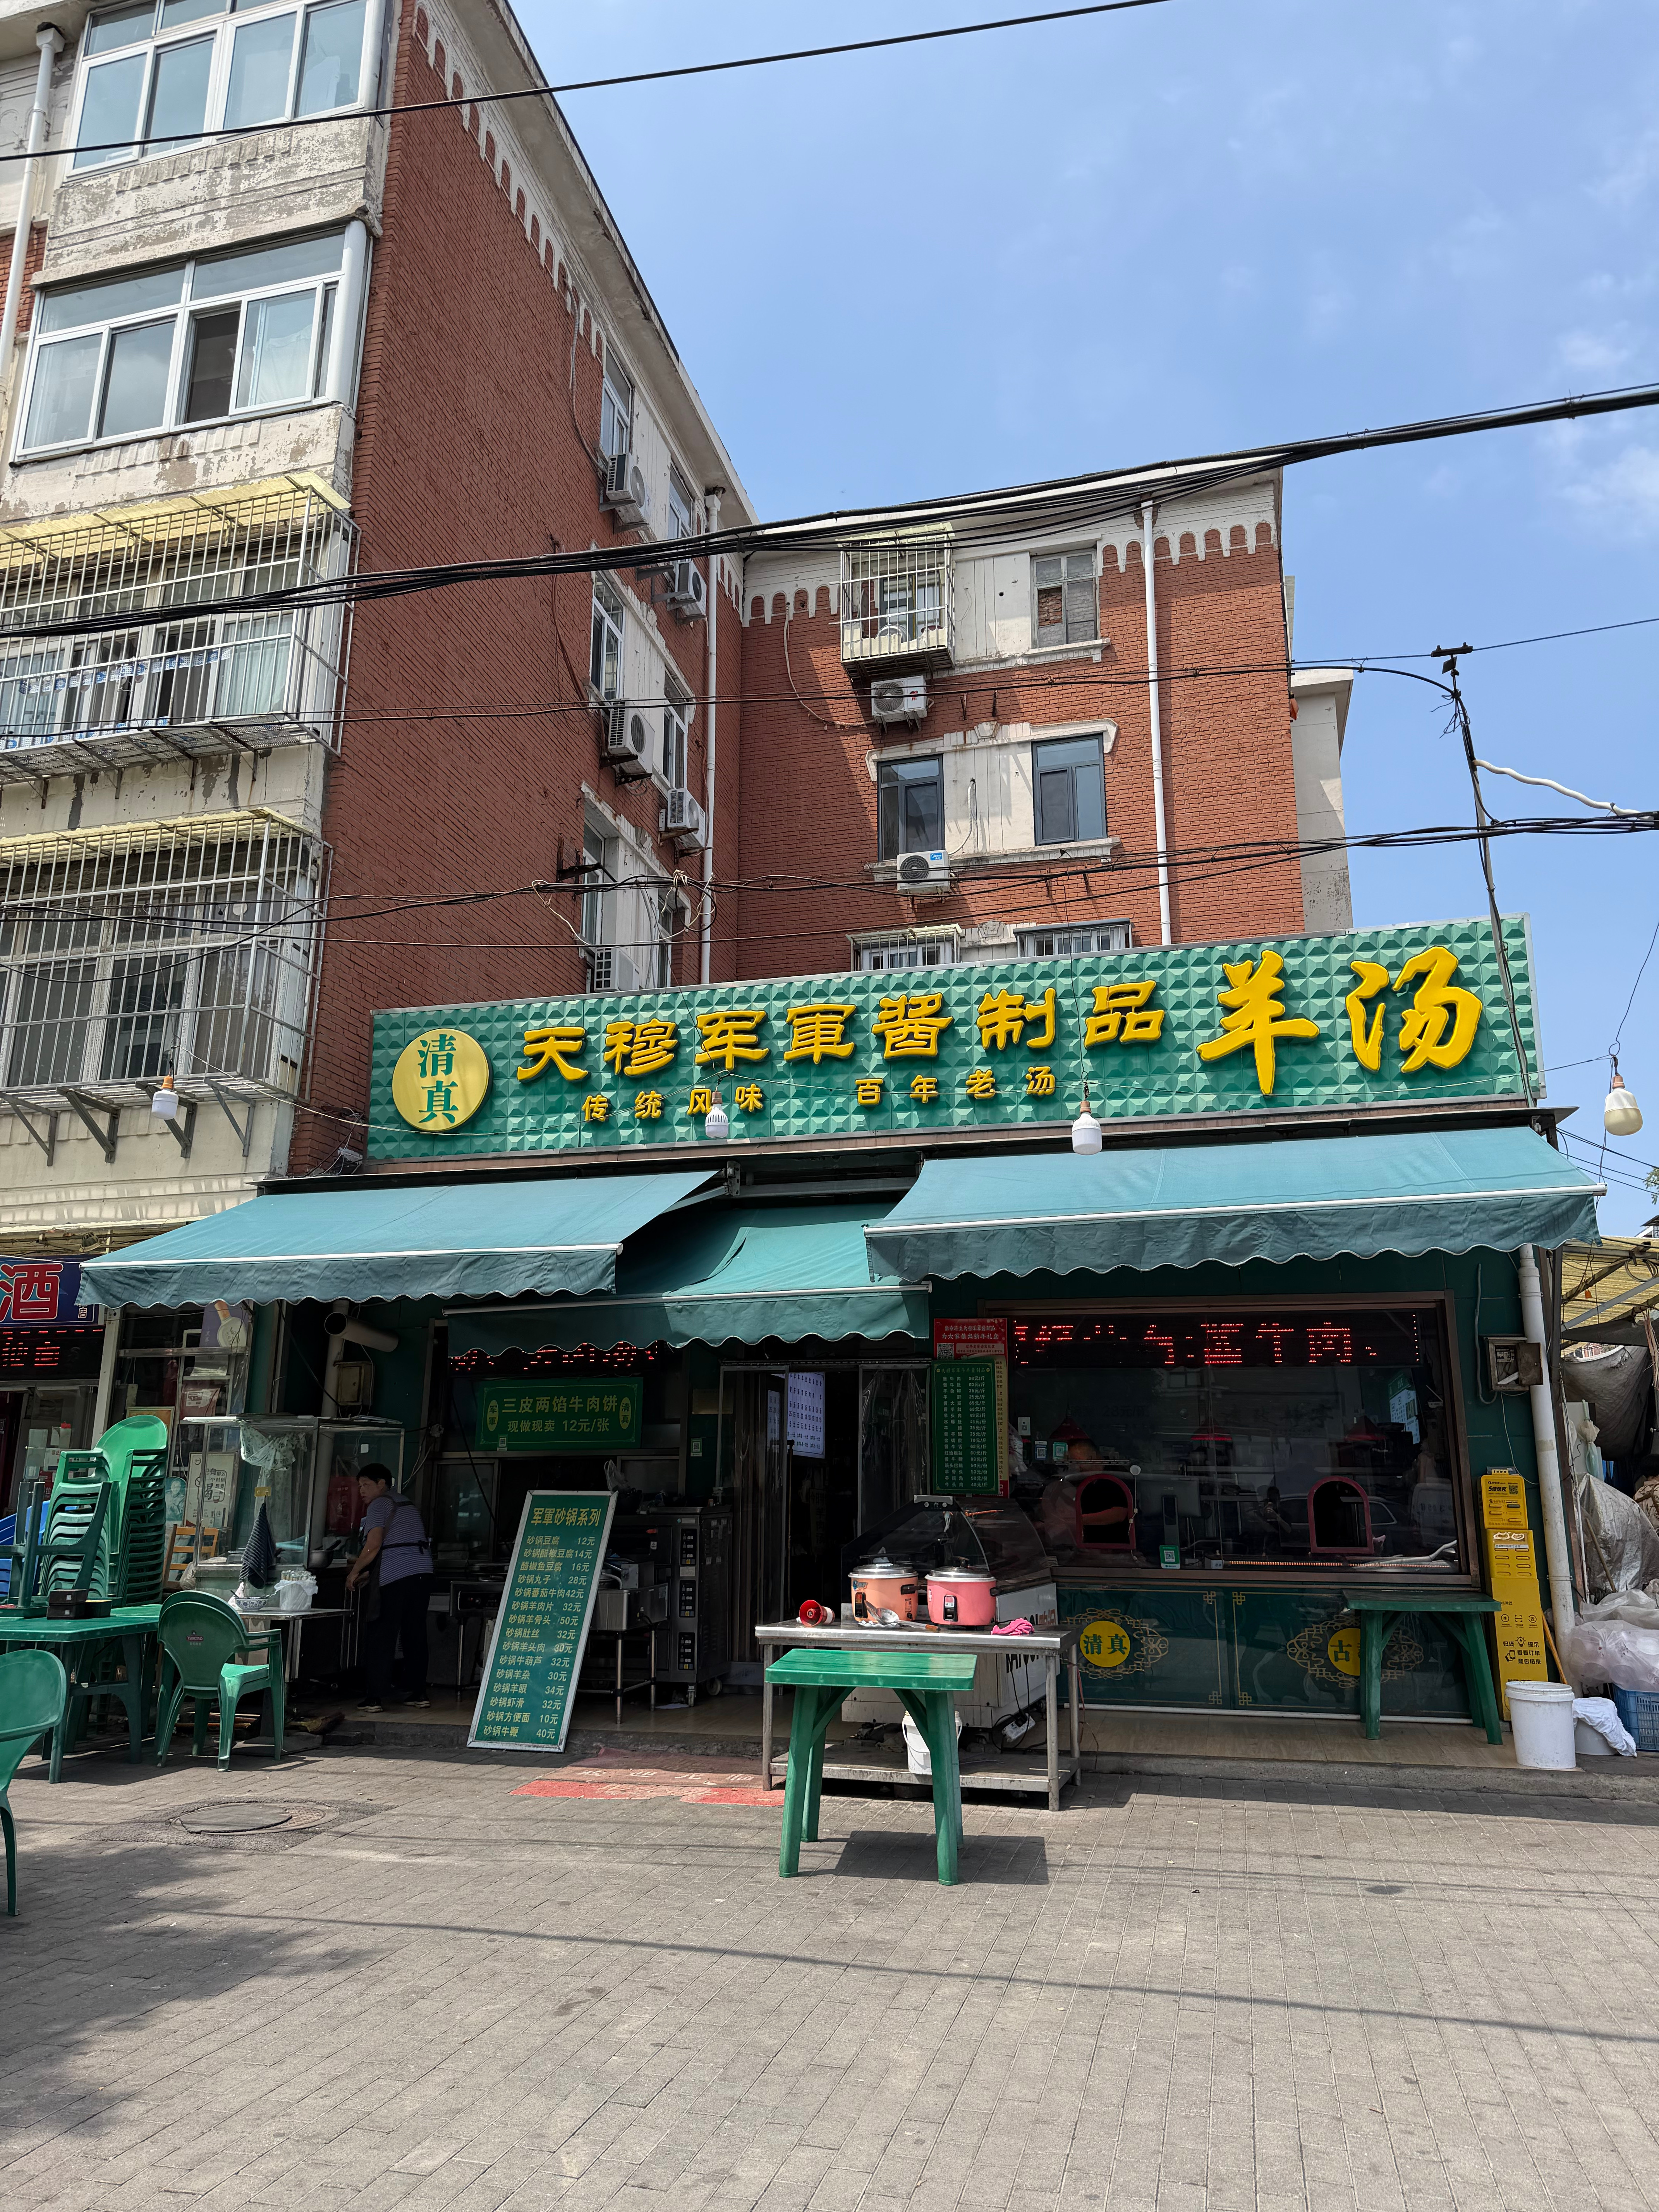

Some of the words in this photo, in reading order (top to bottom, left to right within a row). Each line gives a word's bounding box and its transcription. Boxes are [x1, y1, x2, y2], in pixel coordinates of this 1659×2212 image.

[1196, 945, 1482, 1096] 羊汤
[417, 1034, 459, 1124] 清真
[582, 1083, 763, 1122] 传统风味
[855, 1066, 1056, 1106] 百年老汤
[0, 1263, 63, 1322] 酒
[502, 1395, 618, 1413] 三皮两馅牛肉饼
[621, 1403, 630, 1424] 清真
[507, 1420, 555, 1432] 现做现卖
[563, 1418, 610, 1432] 12元/张
[527, 1535, 560, 1546] 砂锅豆腐
[577, 1536, 595, 1546] 12元
[524, 1548, 574, 1559] 砂锅醋椒豆腐
[574, 1549, 593, 1559] 14元
[520, 1561, 563, 1571] 醋椒鱼豆腐
[572, 1562, 590, 1571] 16元
[518, 1575, 551, 1585] 砂锅丸子
[568, 1575, 587, 1585] 28元
[565, 1589, 584, 1599] 42元
[512, 1601, 554, 1611] 砂锅羊肉片
[562, 1602, 581, 1612] 32元
[509, 1614, 551, 1625] 砂锅羊骨头
[560, 1616, 579, 1626] 50元
[506, 1628, 539, 1639] 砂锅肚丝
[557, 1629, 576, 1640] 32元
[503, 1641, 545, 1652] 砂锅羊头肉
[554, 1643, 573, 1653] 30元
[1084, 1633, 1131, 1656] 清真
[1330, 1640, 1360, 1663] 古
[500, 1655, 543, 1666] 砂锅牛葫芦
[551, 1657, 570, 1668] 32元
[496, 1669, 530, 1680] 砂锅羊杂
[548, 1671, 567, 1681] 30元
[493, 1683, 527, 1694] 砂锅羊眼
[545, 1685, 564, 1696] 34元
[490, 1697, 524, 1708] 砂锅虾滑
[542, 1700, 562, 1710] 32元
[487, 1711, 531, 1723] 砂锅方便面
[540, 1714, 558, 1724] 10元
[483, 1725, 519, 1737] 砂锅牛鞭
[536, 1728, 556, 1739] 40元
